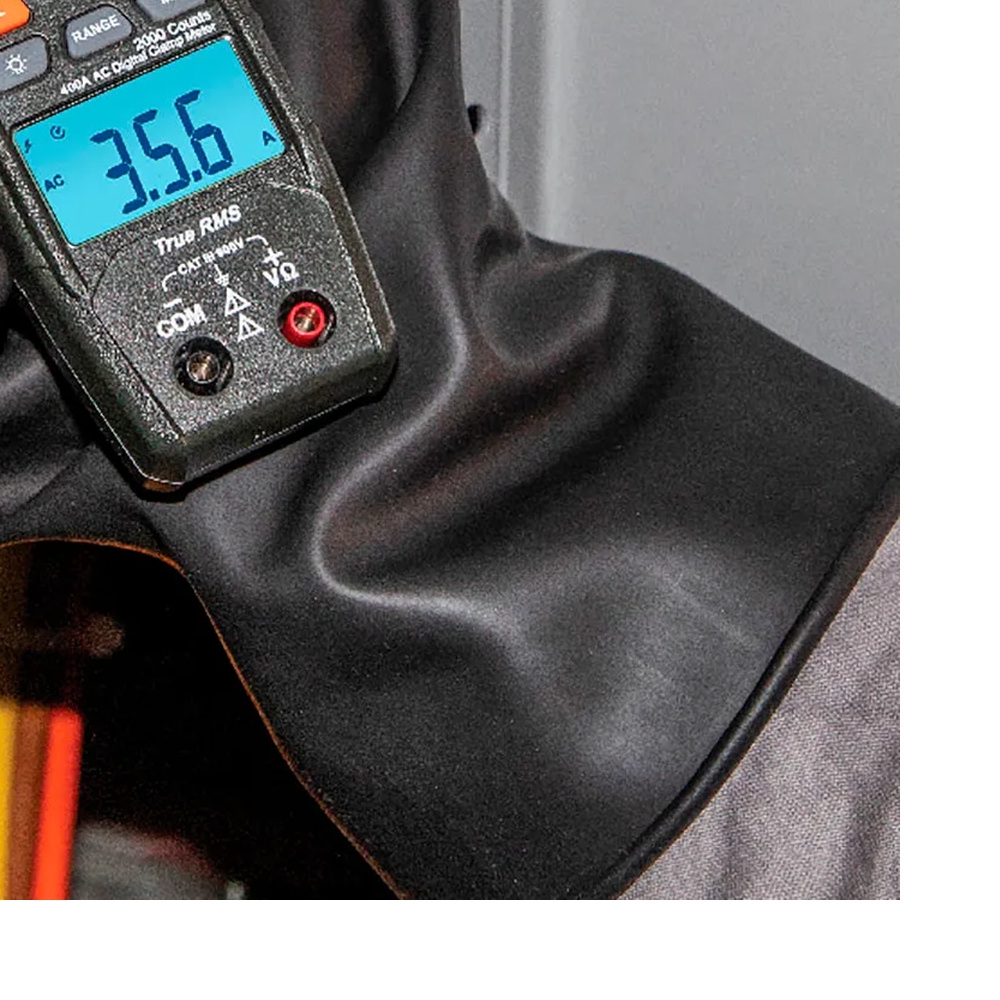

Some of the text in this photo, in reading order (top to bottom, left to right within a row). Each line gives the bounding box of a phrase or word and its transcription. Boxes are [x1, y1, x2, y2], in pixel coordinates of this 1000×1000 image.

[71, 15, 121, 43] RANGE
[133, 10, 212, 51] 2000 Counts
[60, 22, 217, 96] 400A AC Digital Clamp Meter
[262, 131, 276, 146] A
[44, 174, 65, 192] AC
[154, 204, 242, 256] True RMS
[177, 256, 202, 276] CAT
[156, 303, 207, 338] COM
